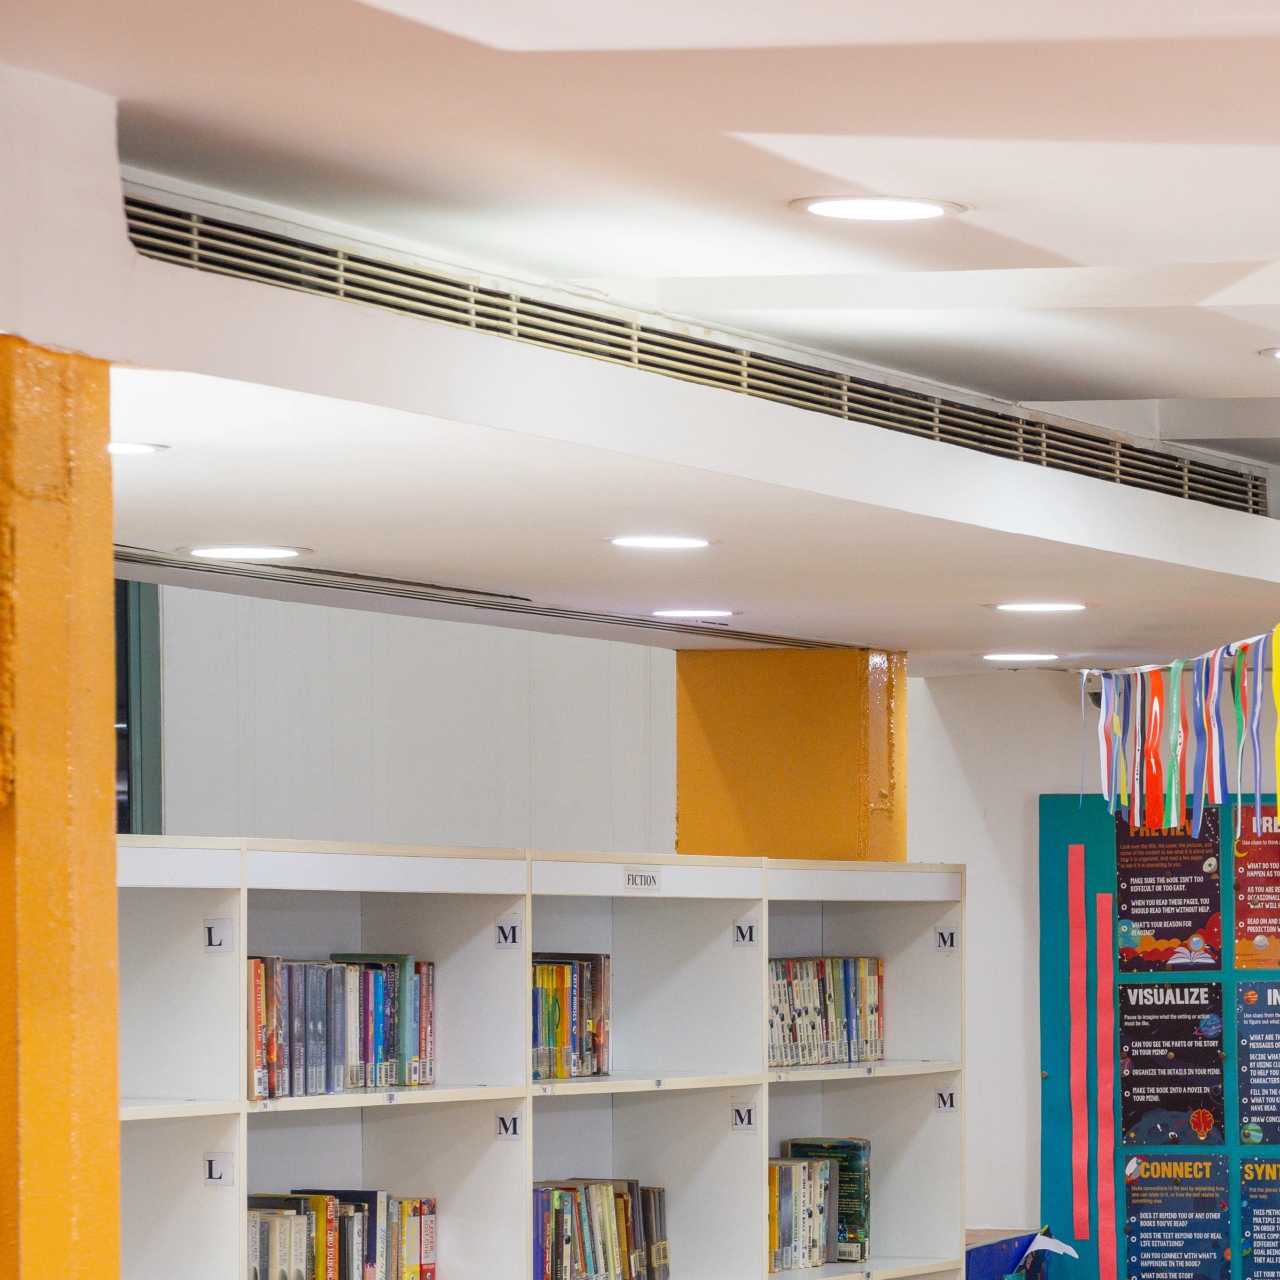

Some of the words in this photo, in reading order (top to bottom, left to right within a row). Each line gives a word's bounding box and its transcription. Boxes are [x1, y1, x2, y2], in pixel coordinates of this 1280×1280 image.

[628, 875, 656, 886] FICTION
[205, 927, 222, 946] L
[496, 926, 517, 943] M
[736, 926, 754, 941] M
[938, 932, 954, 947] M
[1127, 988, 1209, 1005] VISUALIZE
[937, 1093, 954, 1108] M
[734, 1109, 752, 1125] M
[497, 1117, 517, 1134] M
[206, 1160, 222, 1179] L
[1140, 1162, 1212, 1178] CONNECT
